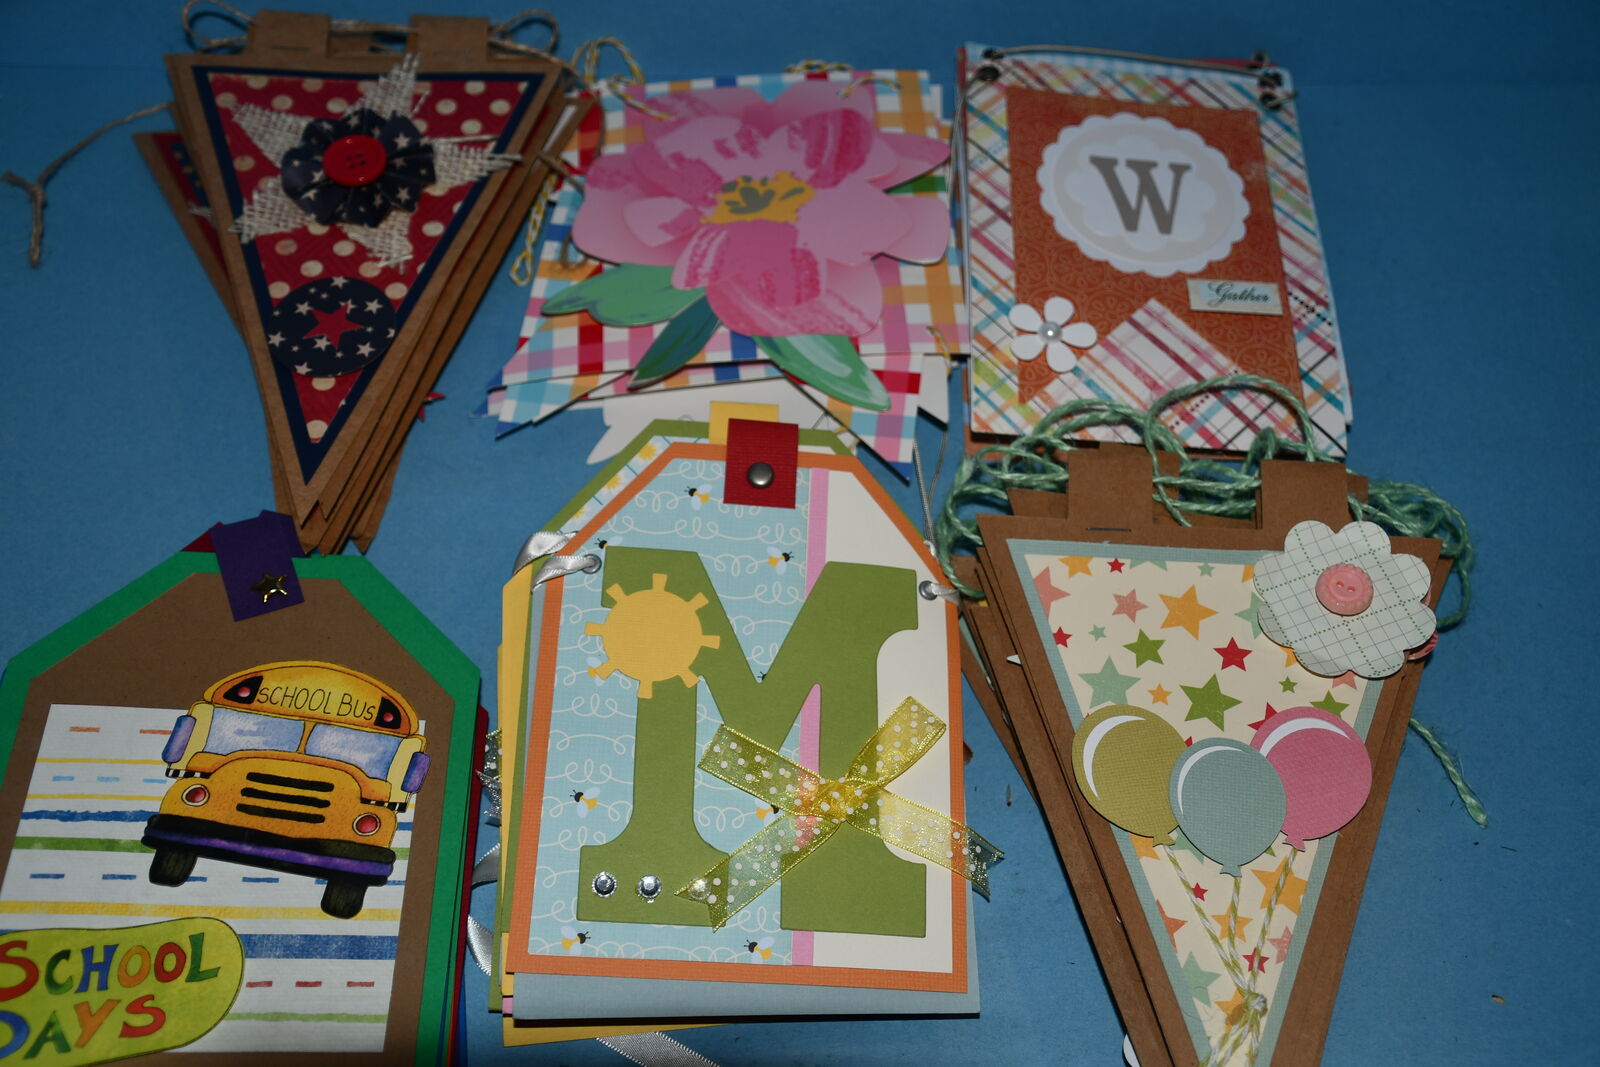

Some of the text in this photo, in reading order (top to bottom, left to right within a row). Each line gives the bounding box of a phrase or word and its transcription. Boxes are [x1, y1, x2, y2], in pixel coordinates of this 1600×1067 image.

[1089, 155, 1192, 235] W
[1207, 281, 1270, 308] Gather
[257, 686, 331, 715] SCHOOL
[577, 545, 927, 938] M
[0, 932, 221, 1001] SCHOOL
